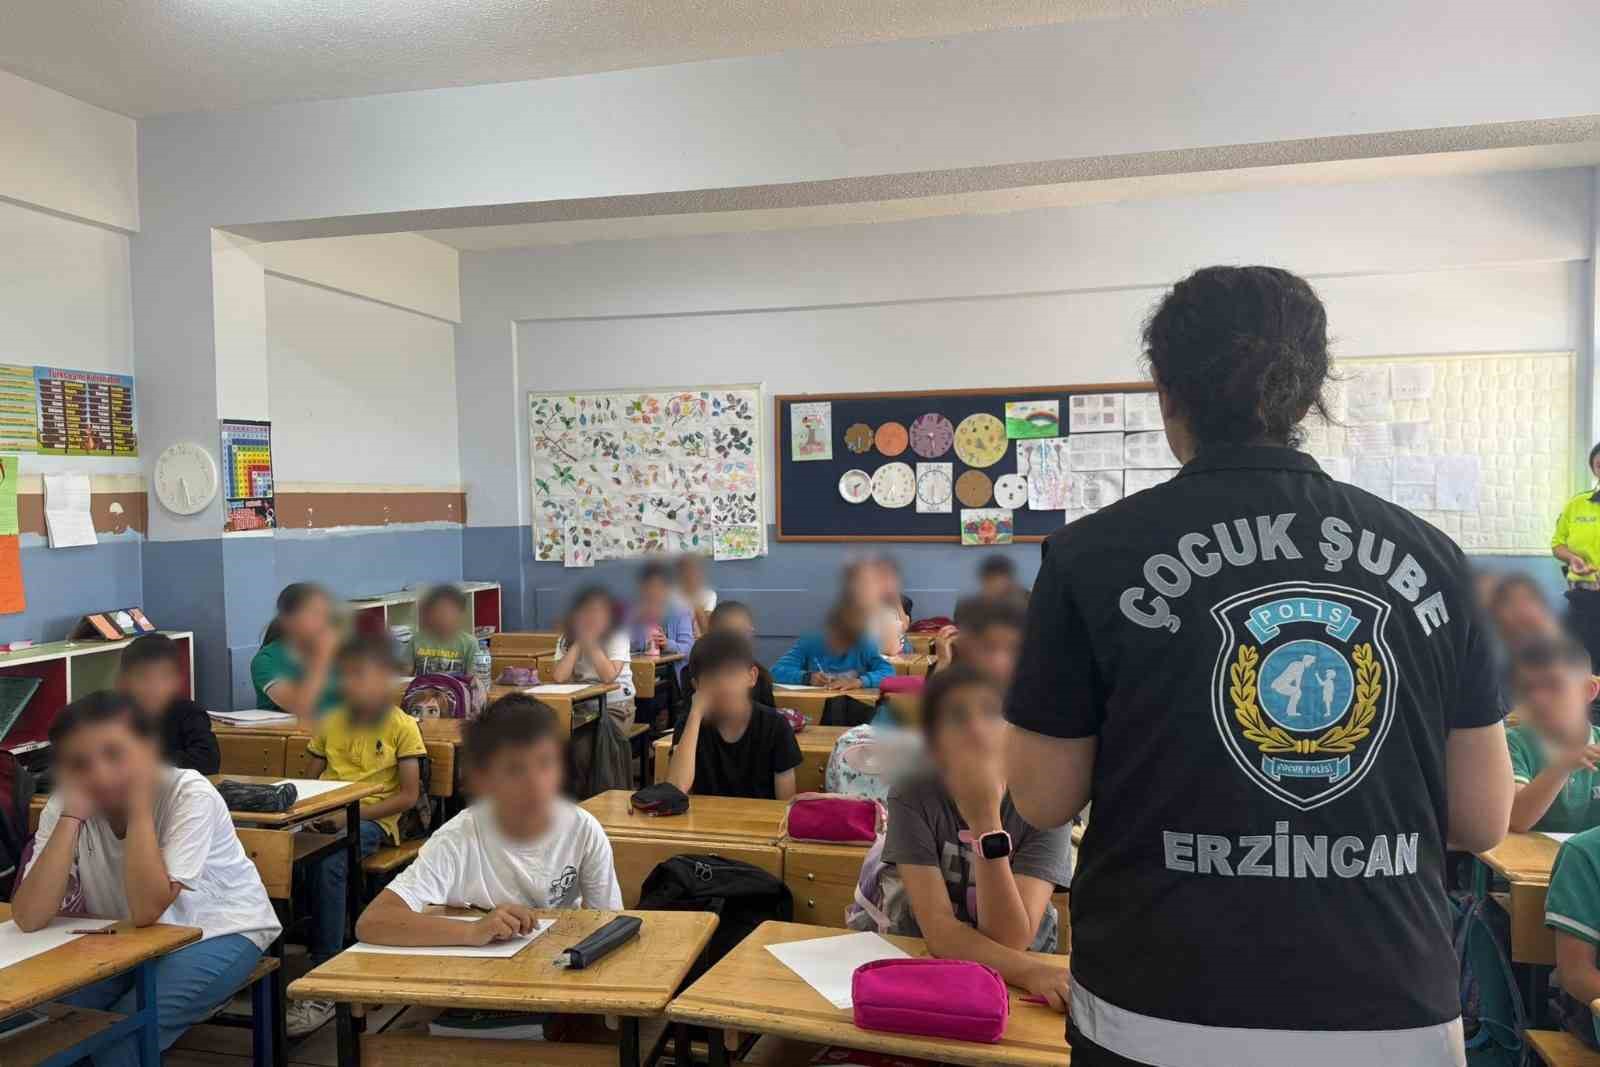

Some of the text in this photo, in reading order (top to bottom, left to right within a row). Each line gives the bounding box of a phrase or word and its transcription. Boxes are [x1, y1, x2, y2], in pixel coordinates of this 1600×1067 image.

[1119, 512, 1450, 636] ÇOCUK ŞUBE
[1162, 820, 1419, 878] ERZİNCAN
